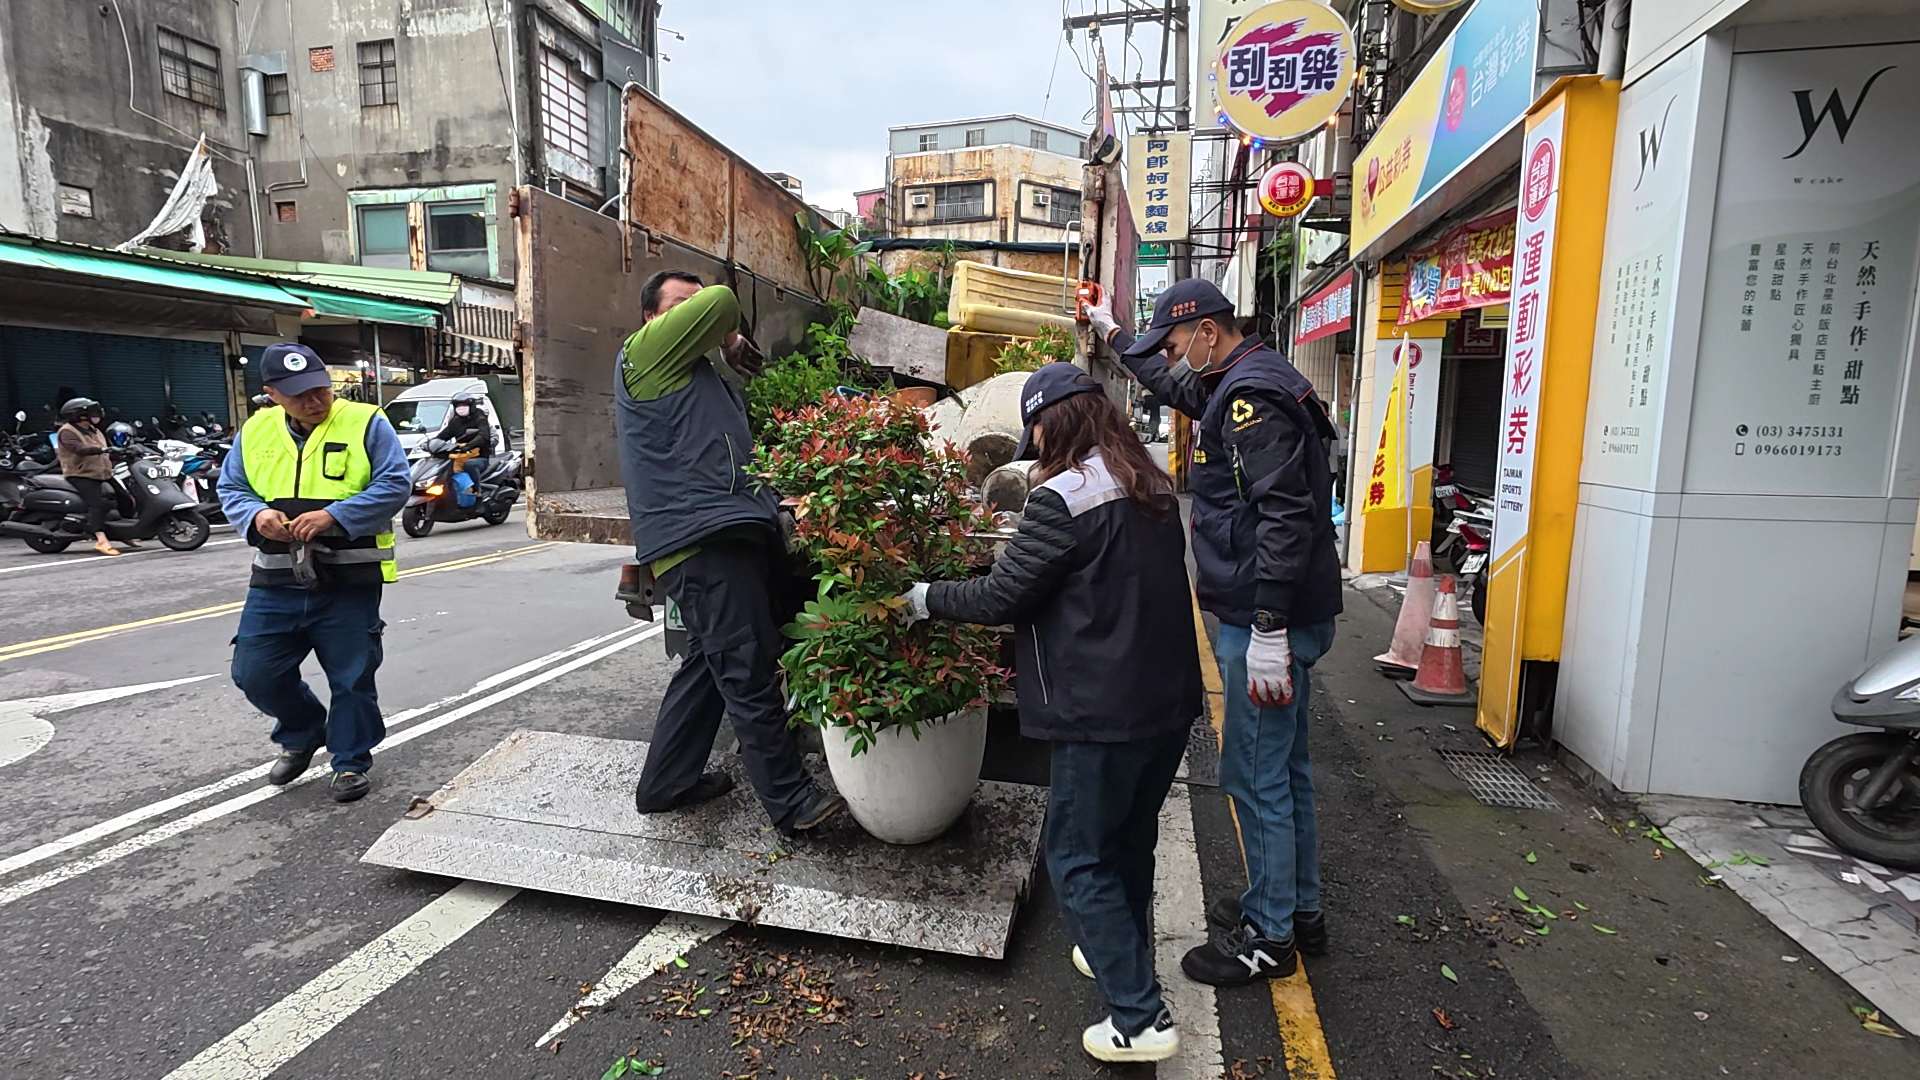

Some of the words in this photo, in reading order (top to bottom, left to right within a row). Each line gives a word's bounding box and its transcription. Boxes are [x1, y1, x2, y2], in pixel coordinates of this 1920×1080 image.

[1229, 46, 1339, 91] 刮刮樂
[1809, 176, 1845, 185] cake
[1769, 242, 1788, 301] 星級甜點
[1507, 231, 1545, 454] 運動彩券
[1755, 425, 1783, 438] (03)
[1787, 426, 1844, 438] 3475131
[1754, 444, 1843, 456] 0966019173
[1503, 467, 1523, 479] TAIWAN
[1501, 483, 1522, 496] SPORTS
[1500, 498, 1524, 513] LOTTERY
